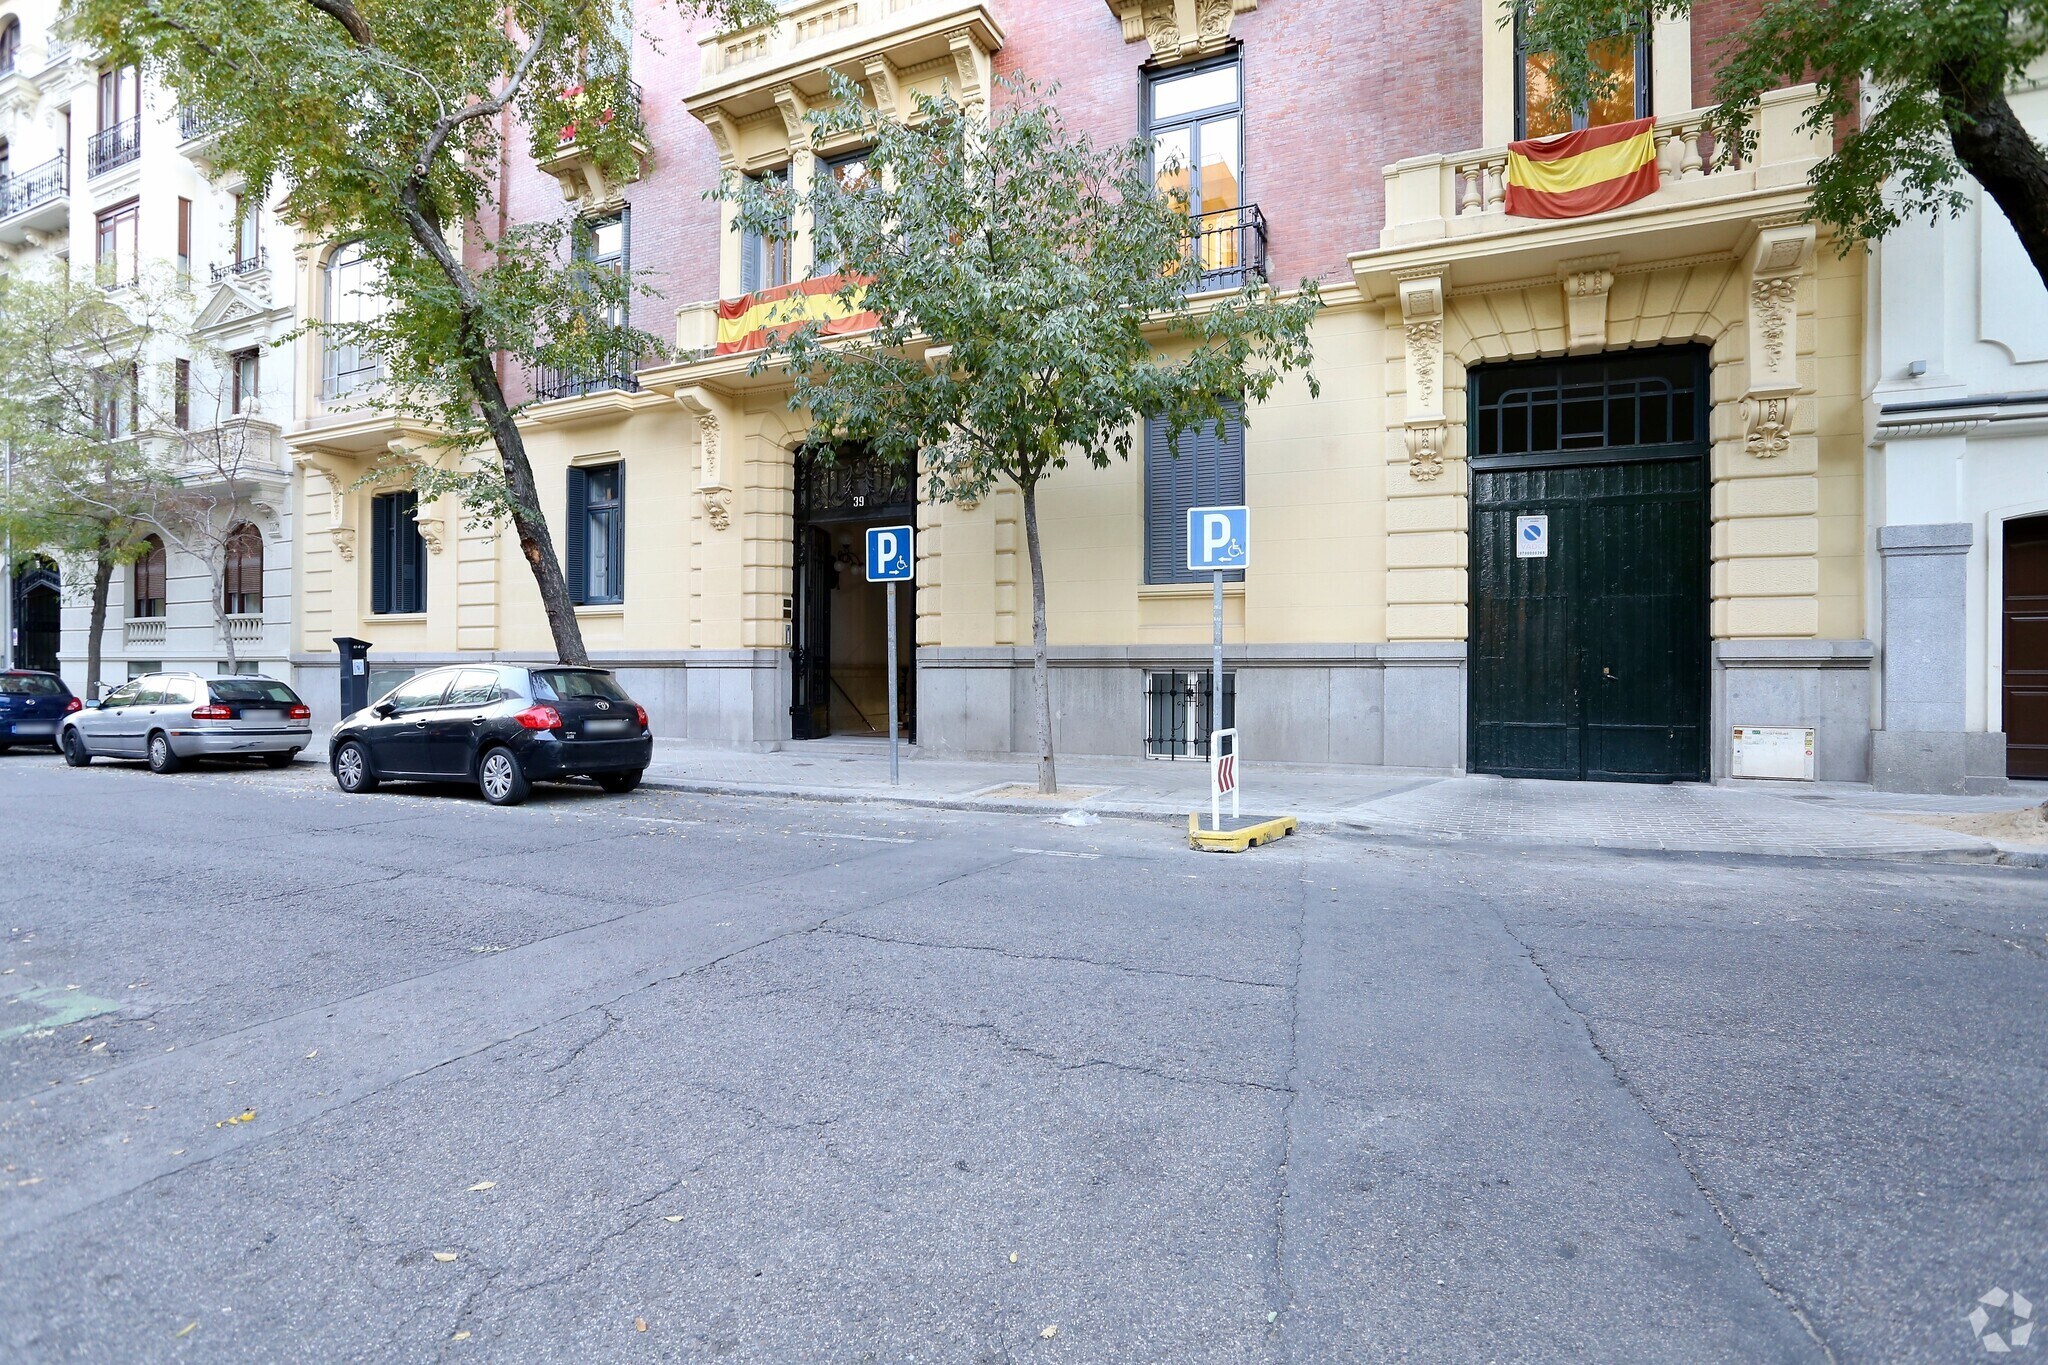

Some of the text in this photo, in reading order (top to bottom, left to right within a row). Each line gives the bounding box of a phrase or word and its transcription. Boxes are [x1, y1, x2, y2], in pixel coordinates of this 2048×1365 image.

[853, 496, 865, 507] 39
[877, 532, 898, 574] P
[1203, 513, 1231, 563] P
